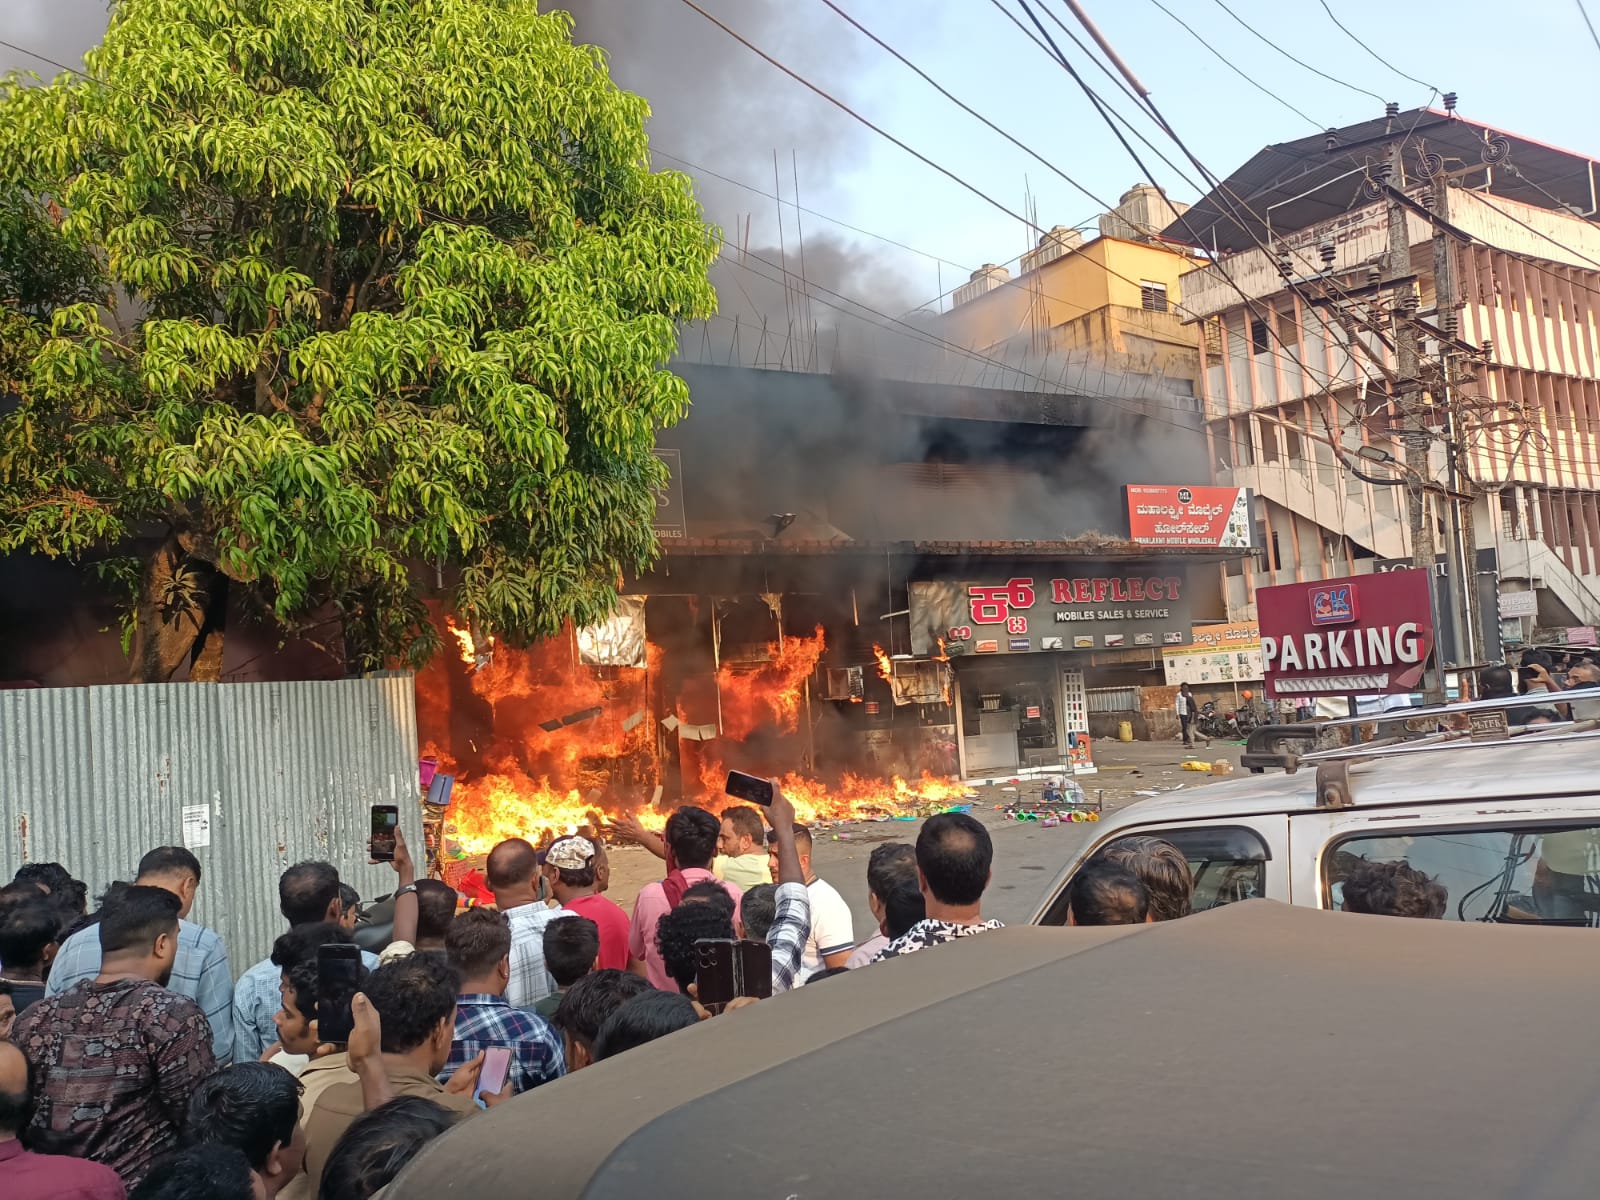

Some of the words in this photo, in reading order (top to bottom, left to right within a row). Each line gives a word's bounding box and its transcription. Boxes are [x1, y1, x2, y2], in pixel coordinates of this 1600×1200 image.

[652, 530, 682, 538] OBILES
[1051, 576, 1182, 604] REFLECT
[1056, 610, 1095, 621] MOBILES
[1097, 609, 1124, 619] SALES
[1126, 609, 1132, 618] &
[1134, 608, 1169, 618] SERVICE
[1260, 622, 1420, 672] PARKING
